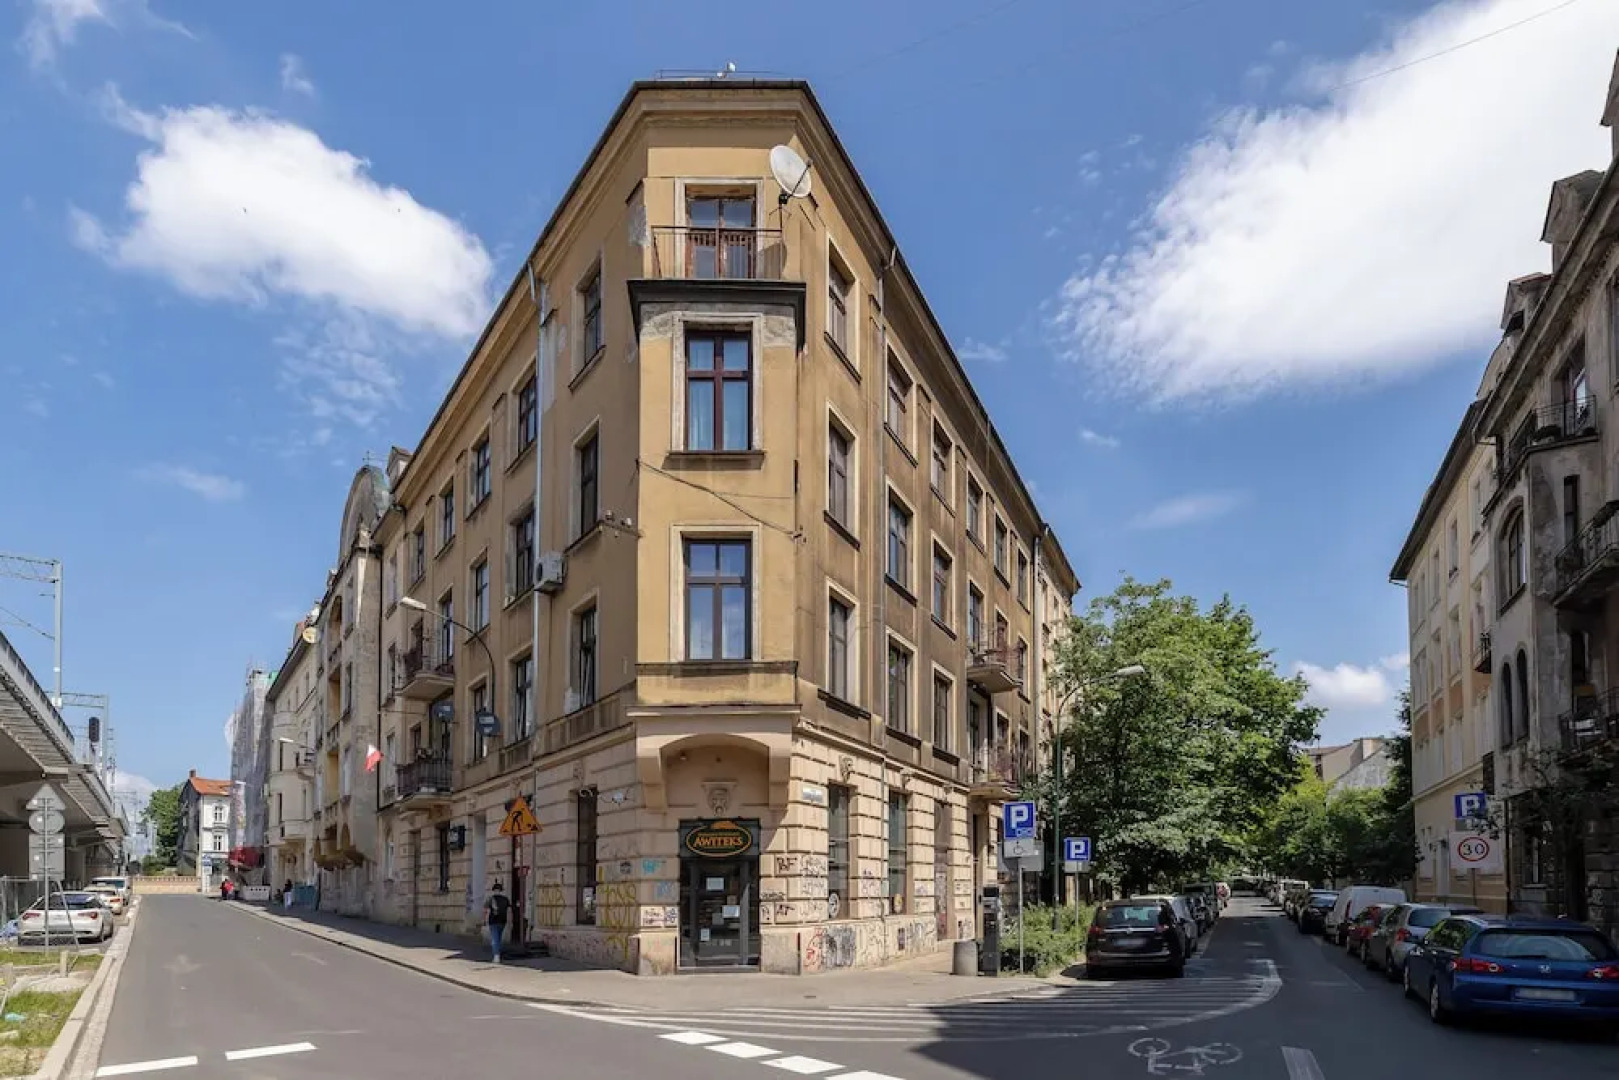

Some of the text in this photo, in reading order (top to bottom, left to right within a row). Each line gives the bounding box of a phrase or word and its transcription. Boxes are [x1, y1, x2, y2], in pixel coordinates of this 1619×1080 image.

[1461, 796, 1480, 817] P
[1010, 805, 1029, 829] P
[693, 836, 743, 848] AWITEKS
[1070, 841, 1086, 859] P
[1463, 843, 1486, 856] 30
